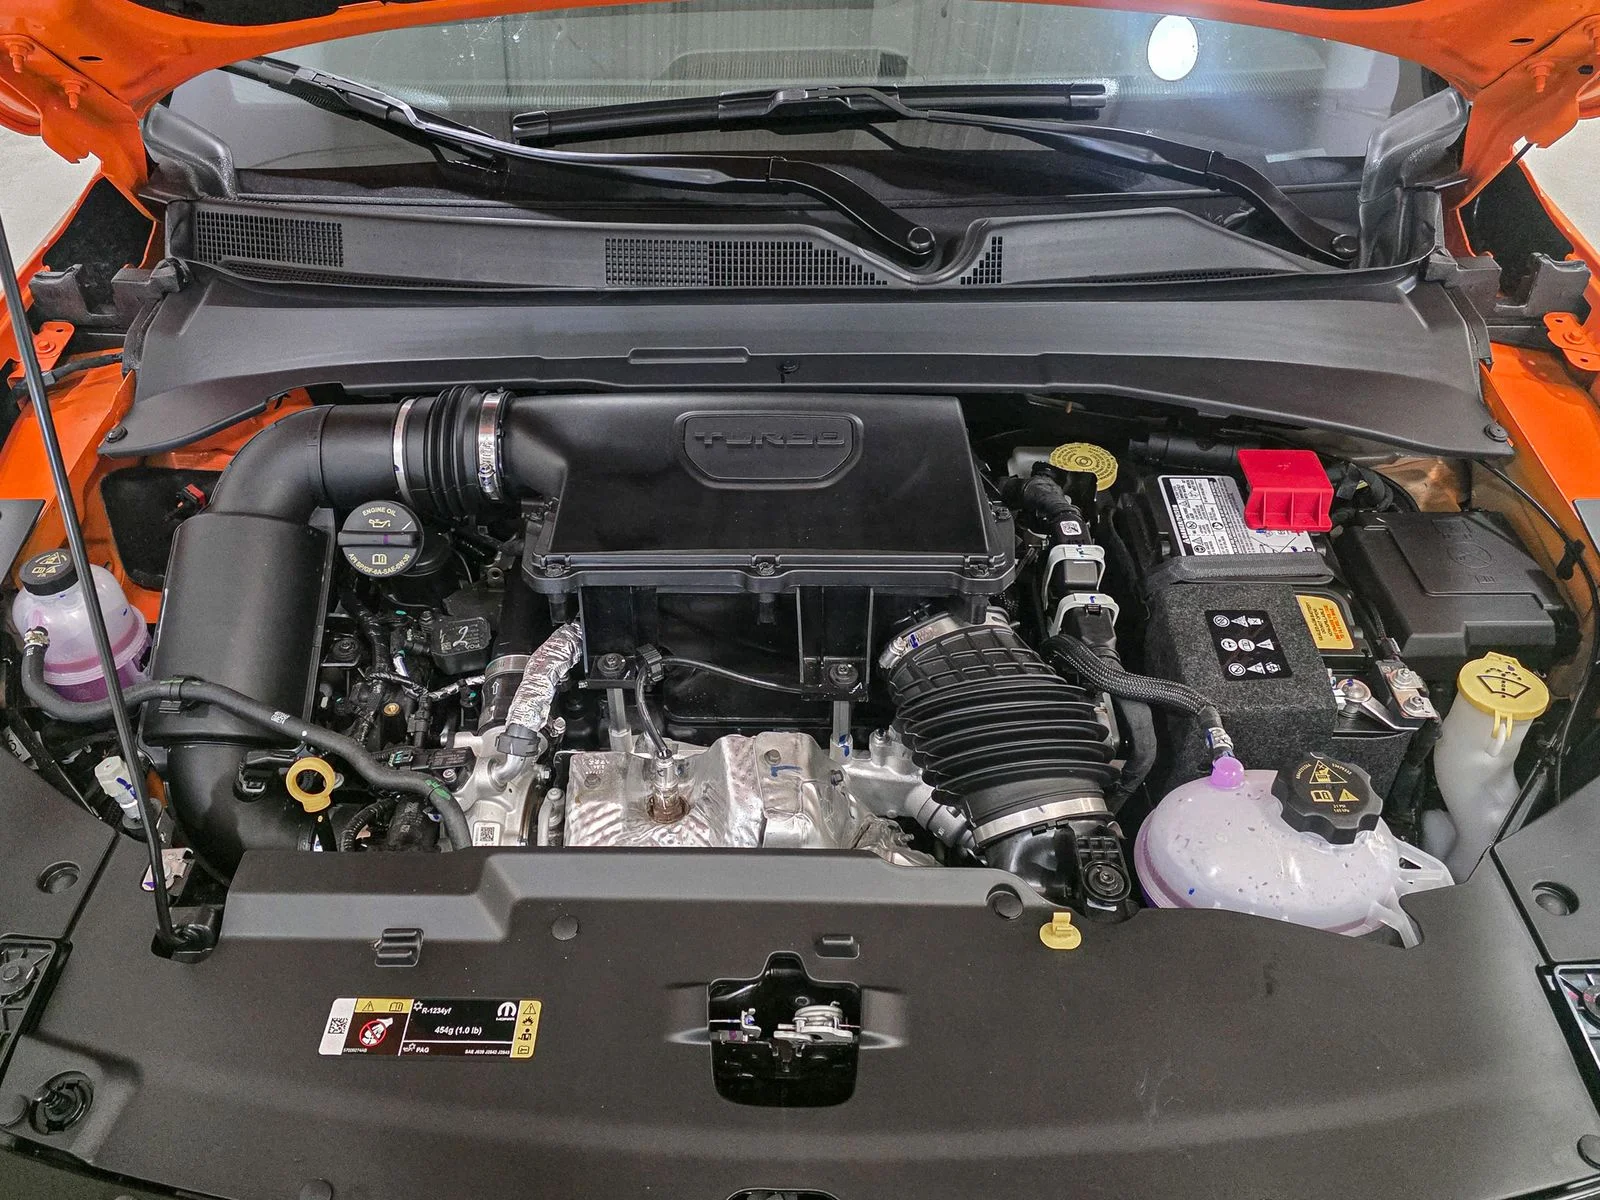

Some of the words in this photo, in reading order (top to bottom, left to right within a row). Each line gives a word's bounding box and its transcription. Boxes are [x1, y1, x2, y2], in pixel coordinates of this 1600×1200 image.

[694, 431, 845, 446] TURBO
[362, 506, 386, 517] ENGINE
[386, 508, 397, 517] OIL
[348, 553, 358, 564] API
[421, 1007, 452, 1015] R-1234yf
[434, 1026, 454, 1035] 454g
[455, 1026, 470, 1035] (1.0
[471, 1026, 482, 1035] lb)
